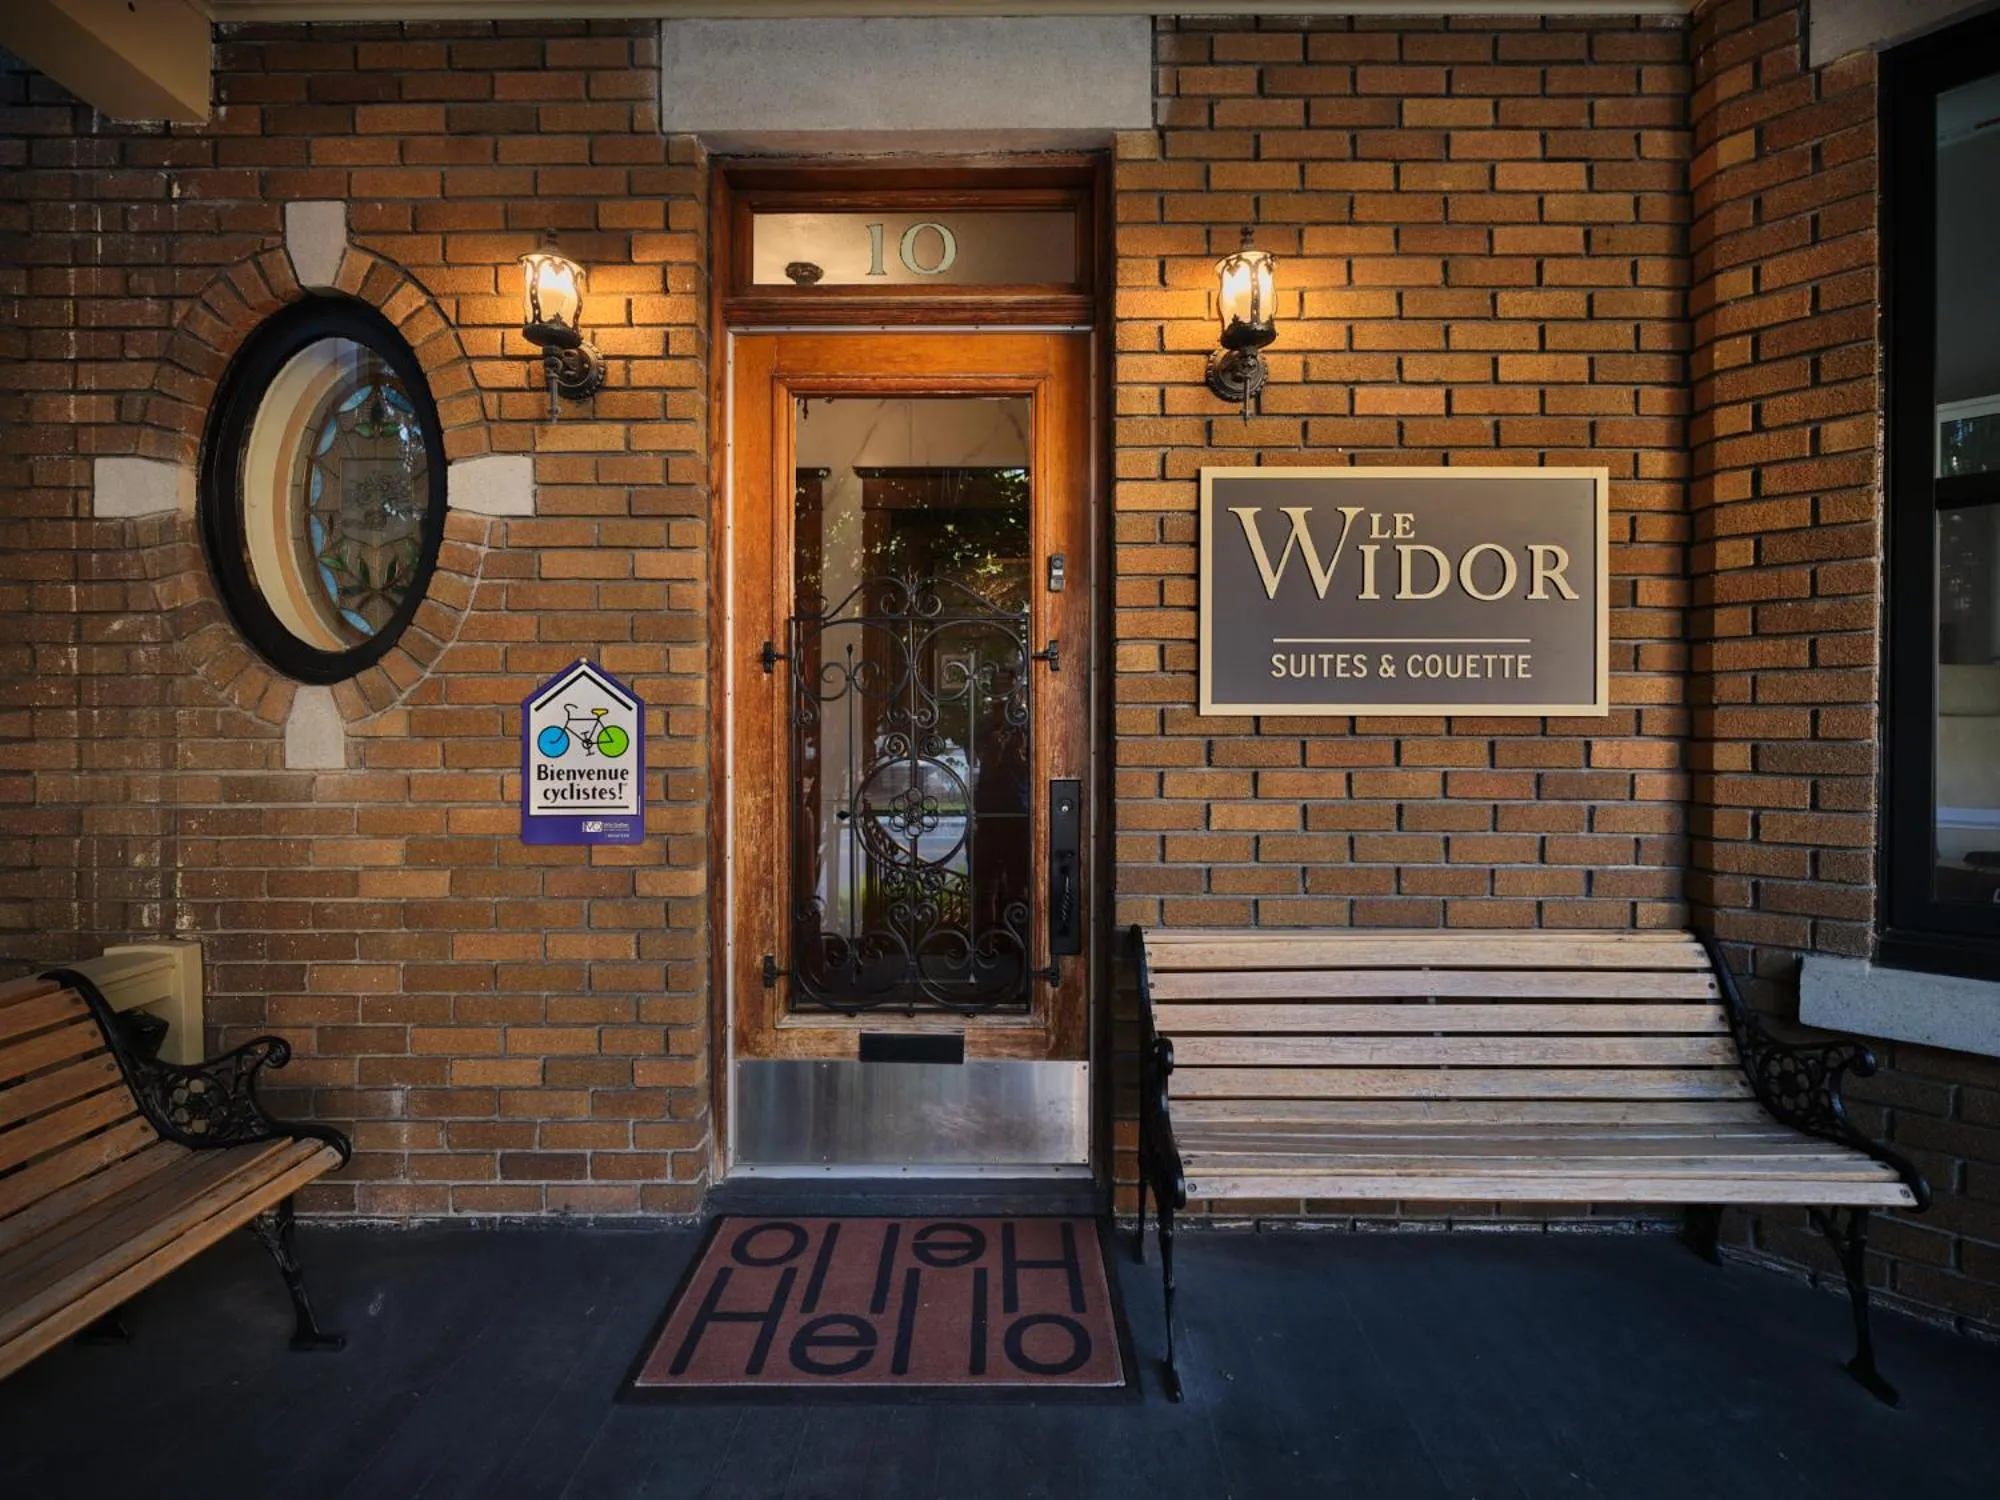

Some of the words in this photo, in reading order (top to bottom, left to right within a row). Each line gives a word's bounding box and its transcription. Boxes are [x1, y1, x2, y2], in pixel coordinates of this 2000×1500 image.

[866, 223, 957, 275] 10
[1370, 512, 1415, 539] LE
[1228, 507, 1579, 600] WIDOR
[1271, 654, 1368, 678] SUITES
[1378, 654, 1396, 678] &
[1406, 654, 1532, 678] COUETTE
[537, 764, 629, 781] Bienvenue
[544, 782, 623, 804] cyclistes!
[731, 1222, 1086, 1314] Hello
[668, 1267, 1092, 1376] Hello
